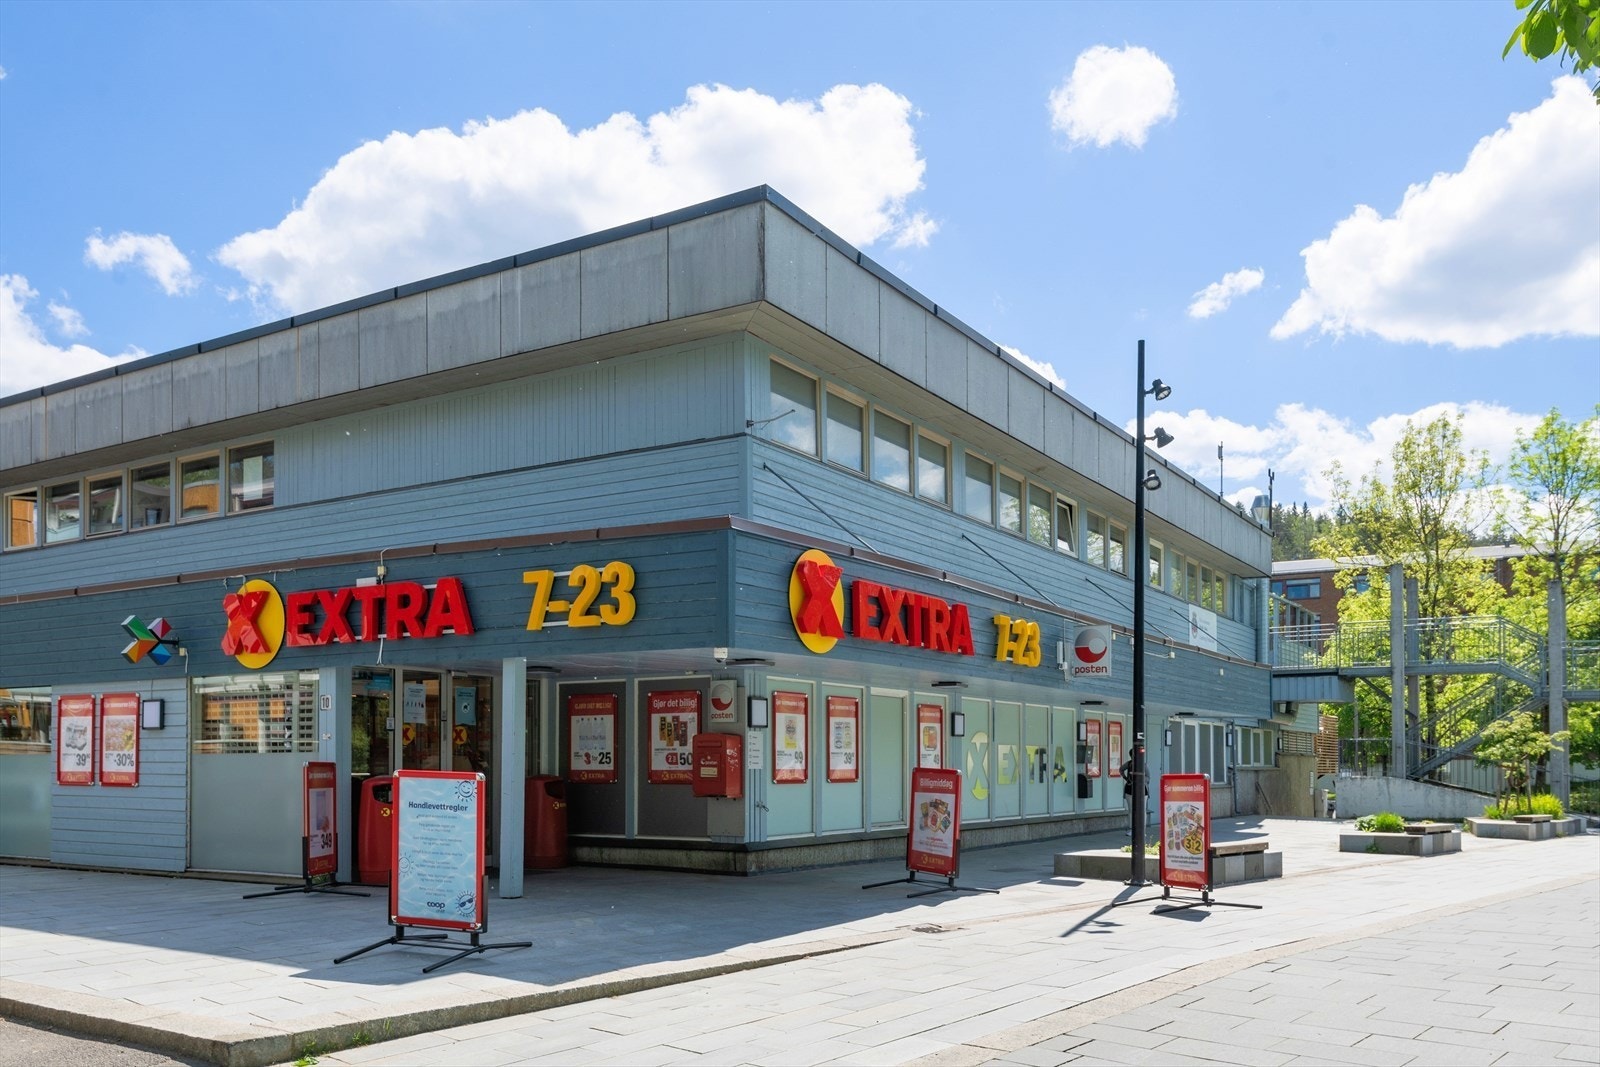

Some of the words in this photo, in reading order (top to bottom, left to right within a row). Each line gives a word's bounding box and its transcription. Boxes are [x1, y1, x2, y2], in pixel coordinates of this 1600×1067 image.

[523, 561, 636, 631] 7-23
[286, 577, 475, 647] EXTRA
[852, 579, 975, 656] EXTRA
[993, 614, 1041, 668] 7-23
[1074, 664, 1108, 675] posten
[322, 697, 330, 708] 10
[667, 698, 678, 707] det
[598, 752, 612, 765] 25
[408, 801, 468, 813] Handlevettregler
[427, 901, 445, 909] coop
